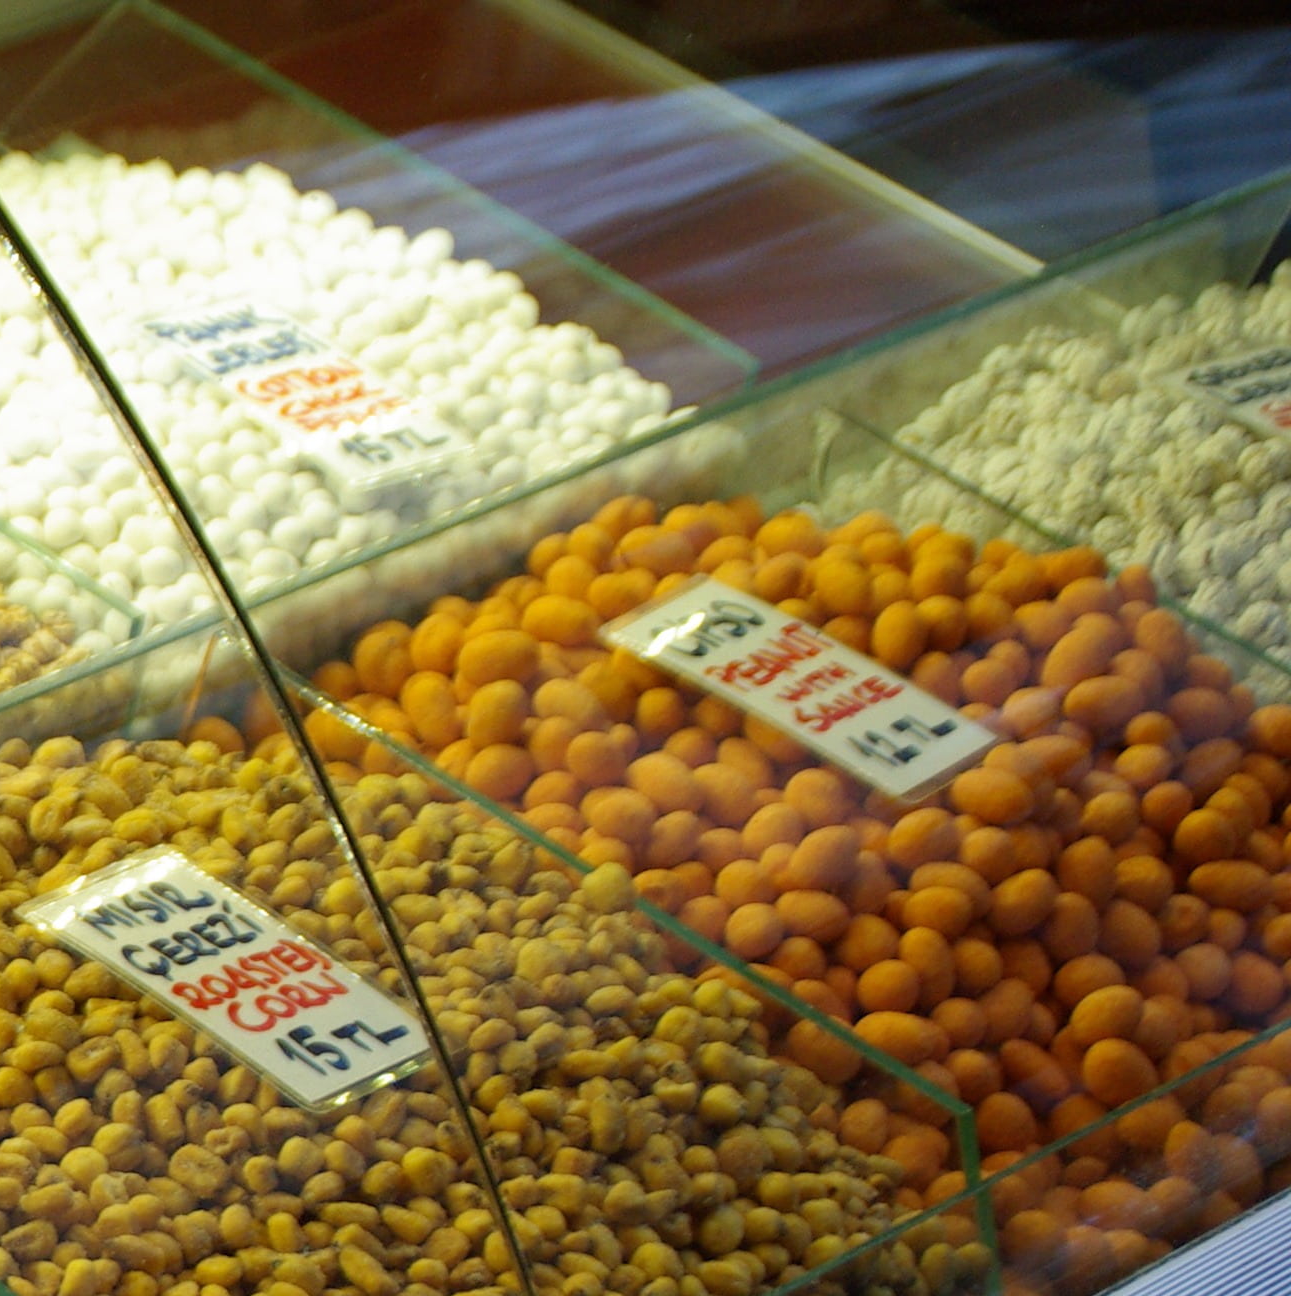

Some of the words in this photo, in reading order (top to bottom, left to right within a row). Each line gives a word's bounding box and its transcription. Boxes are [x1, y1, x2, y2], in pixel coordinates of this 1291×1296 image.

[703, 620, 838, 692] PEANUT
[777, 661, 857, 702] WITH
[793, 675, 906, 733] SAUCE
[892, 714, 959, 741] TL
[76, 880, 215, 940] MISIR
[171, 938, 334, 1011] ROASTED
[227, 971, 349, 1033] CORN
[275, 1024, 351, 1077] 15
[330, 1020, 411, 1052] TL
